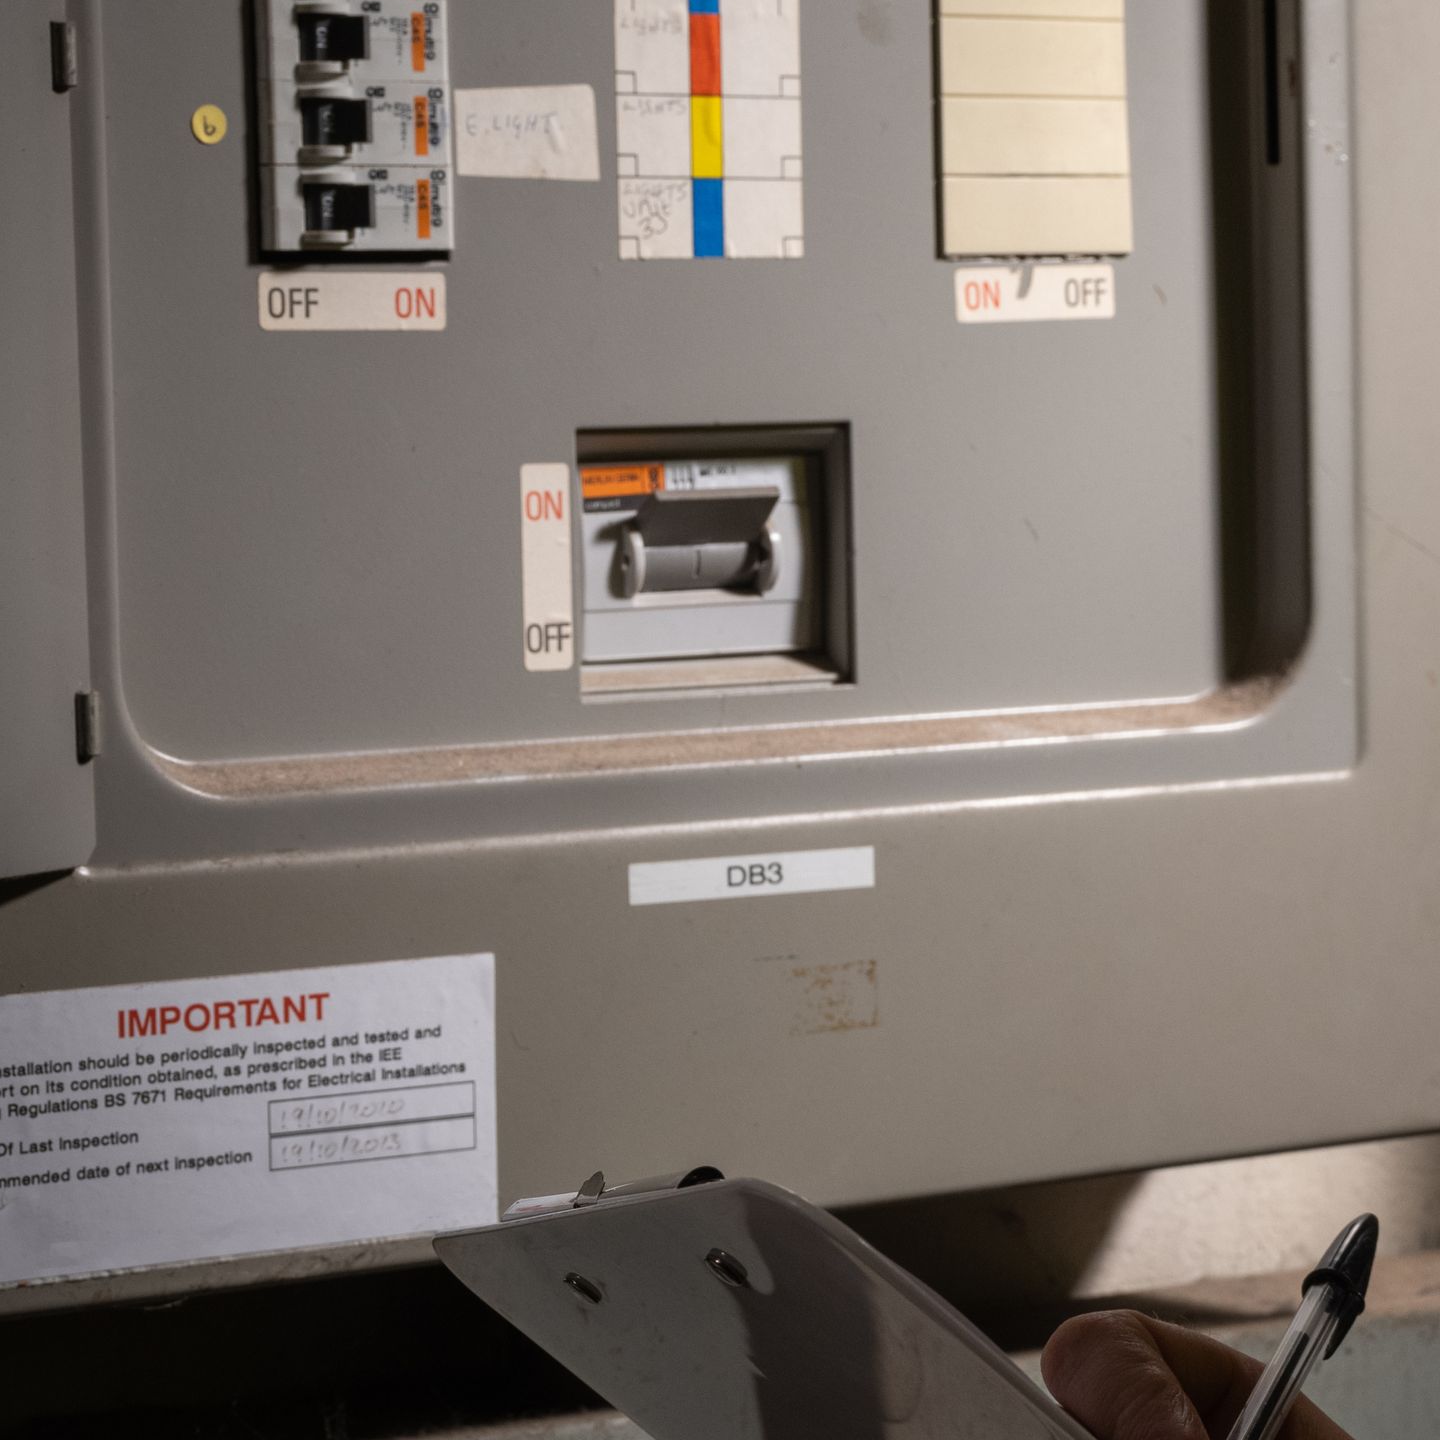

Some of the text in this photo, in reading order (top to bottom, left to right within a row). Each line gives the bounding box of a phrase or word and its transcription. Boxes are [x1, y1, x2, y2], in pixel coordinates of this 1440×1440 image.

[267, 287, 436, 319] OFF ON
[964, 277, 1107, 311] ON OFF
[524, 490, 563, 522] ON
[526, 622, 571, 653] OFF
[726, 861, 784, 888] DB3
[117, 991, 330, 1039] IMPORTANT
[77, 1052, 130, 1072] should
[134, 1051, 155, 1066] be
[159, 1042, 248, 1067] periodically
[252, 1034, 326, 1056] inspected
[330, 1032, 359, 1048] and
[363, 1027, 409, 1044] tested
[413, 1024, 442, 1040] and
[18, 1083, 40, 1097] on
[45, 1079, 65, 1094] its
[69, 1073, 142, 1092] condition
[146, 1064, 218, 1085] obtained,
[222, 1062, 244, 1078] as
[246, 1054, 327, 1078] prescribed
[331, 1053, 346, 1066] in
[348, 1050, 374, 1065] the
[377, 1045, 402, 1062] IEE
[6, 1097, 98, 1119] Regulations
[103, 1091, 126, 1108] BS
[131, 1088, 166, 1105] 7671
[173, 1079, 277, 1102] Requirements
[281, 1076, 302, 1091] for
[306, 1068, 376, 1089] Electrical
[380, 1061, 466, 1080] Installations
[18, 1138, 53, 1155] Last
[58, 1130, 139, 1151] Inspection
[75, 1164, 110, 1181] date
[114, 1160, 131, 1177] of
[135, 1158, 169, 1174] next
[173, 1150, 253, 1171] inspection
